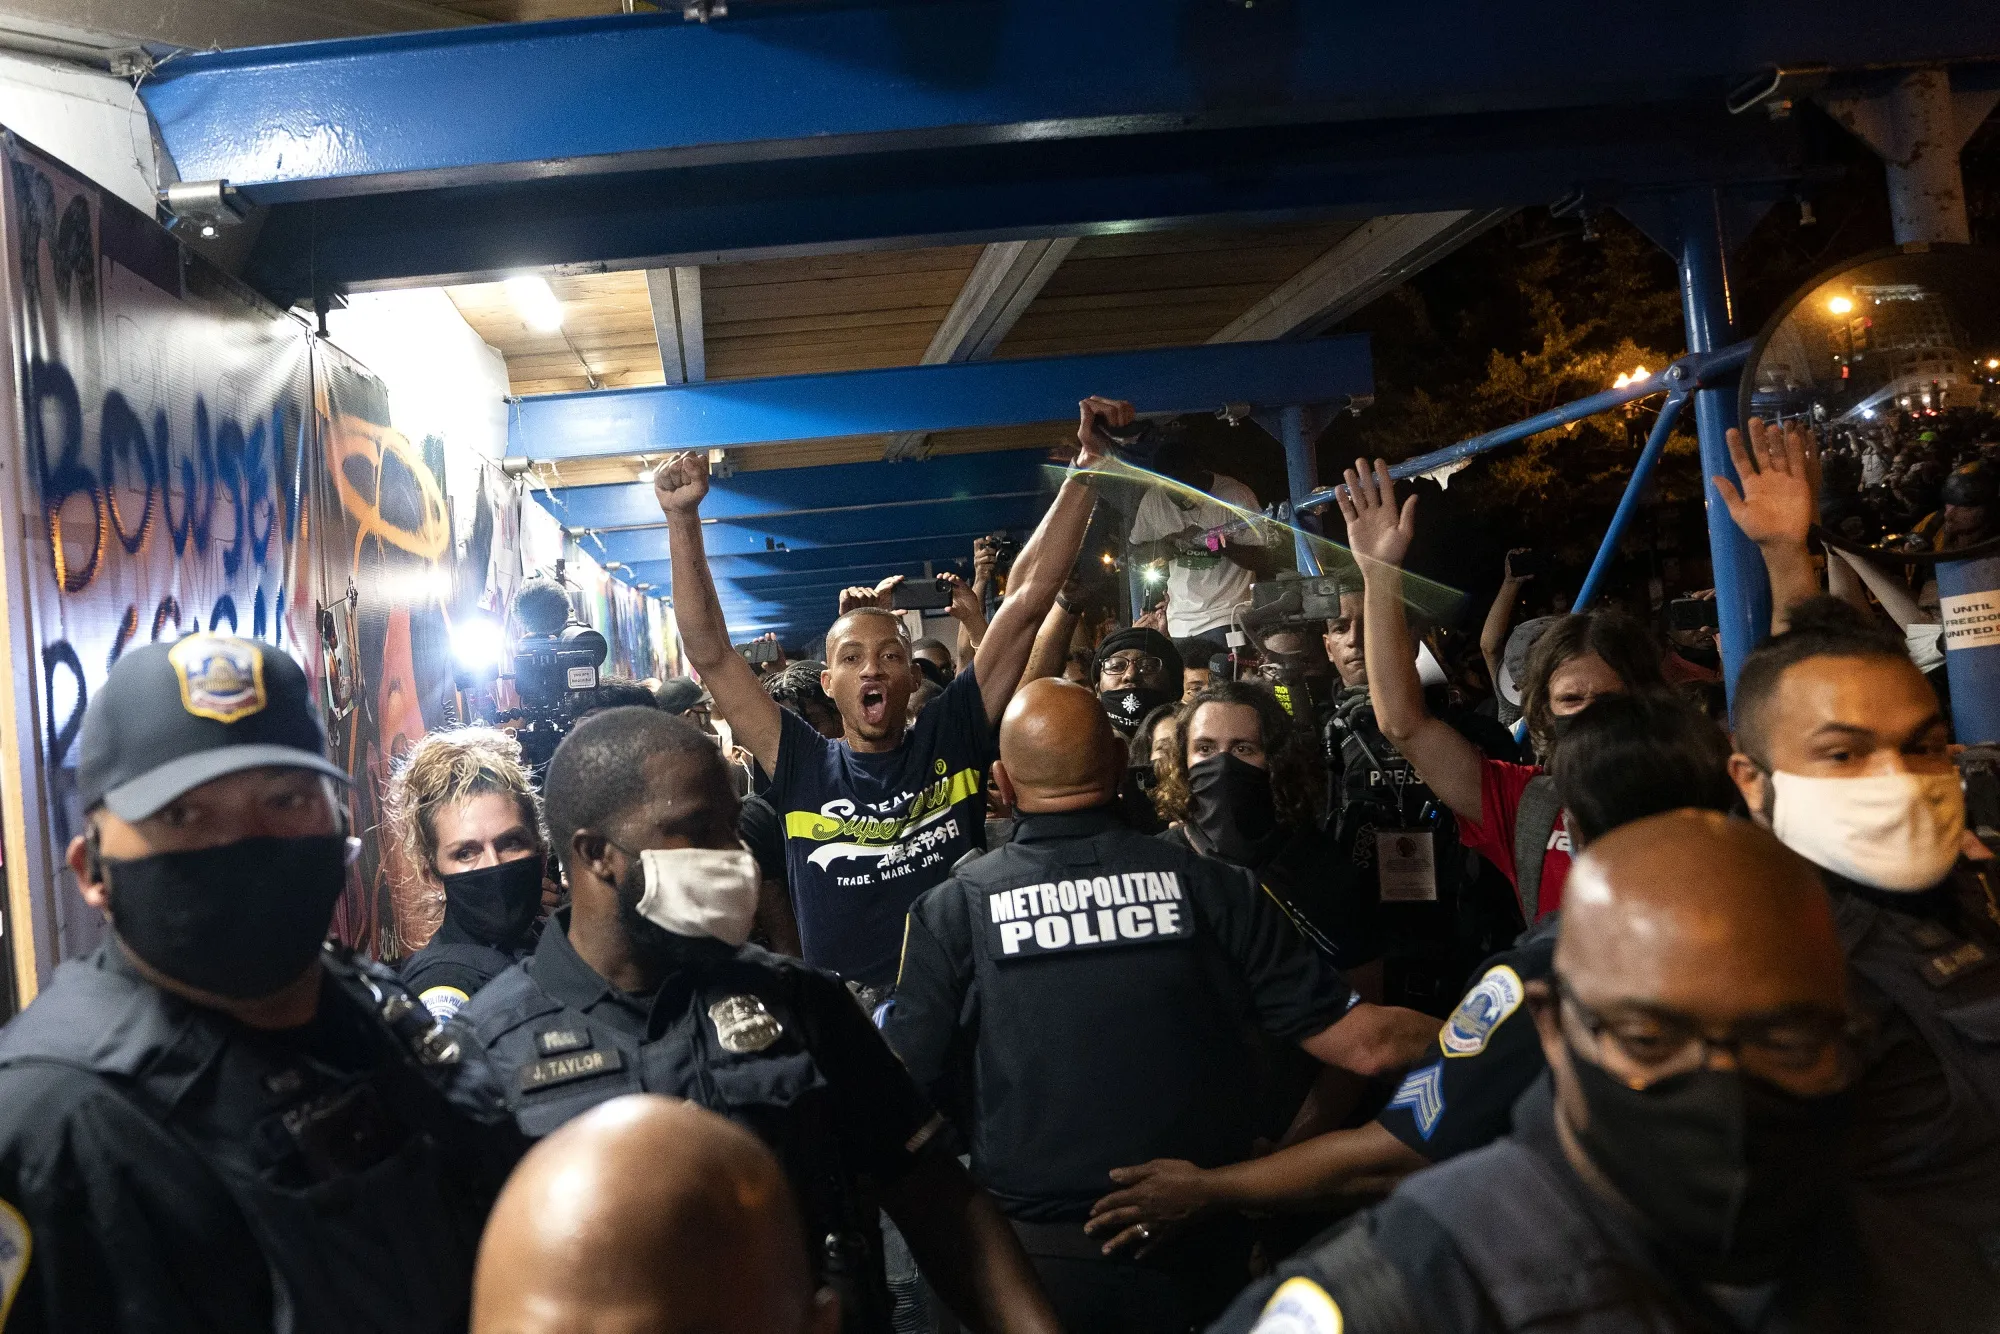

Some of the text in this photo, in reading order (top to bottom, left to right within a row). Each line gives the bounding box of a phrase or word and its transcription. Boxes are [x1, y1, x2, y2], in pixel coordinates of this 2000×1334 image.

[1952, 603, 1994, 613] UNTIL
[1945, 626, 1993, 638] UNITED
[837, 854, 944, 886] TRADE. MARK. JPN.
[989, 871, 1182, 923] METROPOLITAN
[1000, 903, 1182, 954] POLICE
[548, 1052, 604, 1076] TAYLOR
